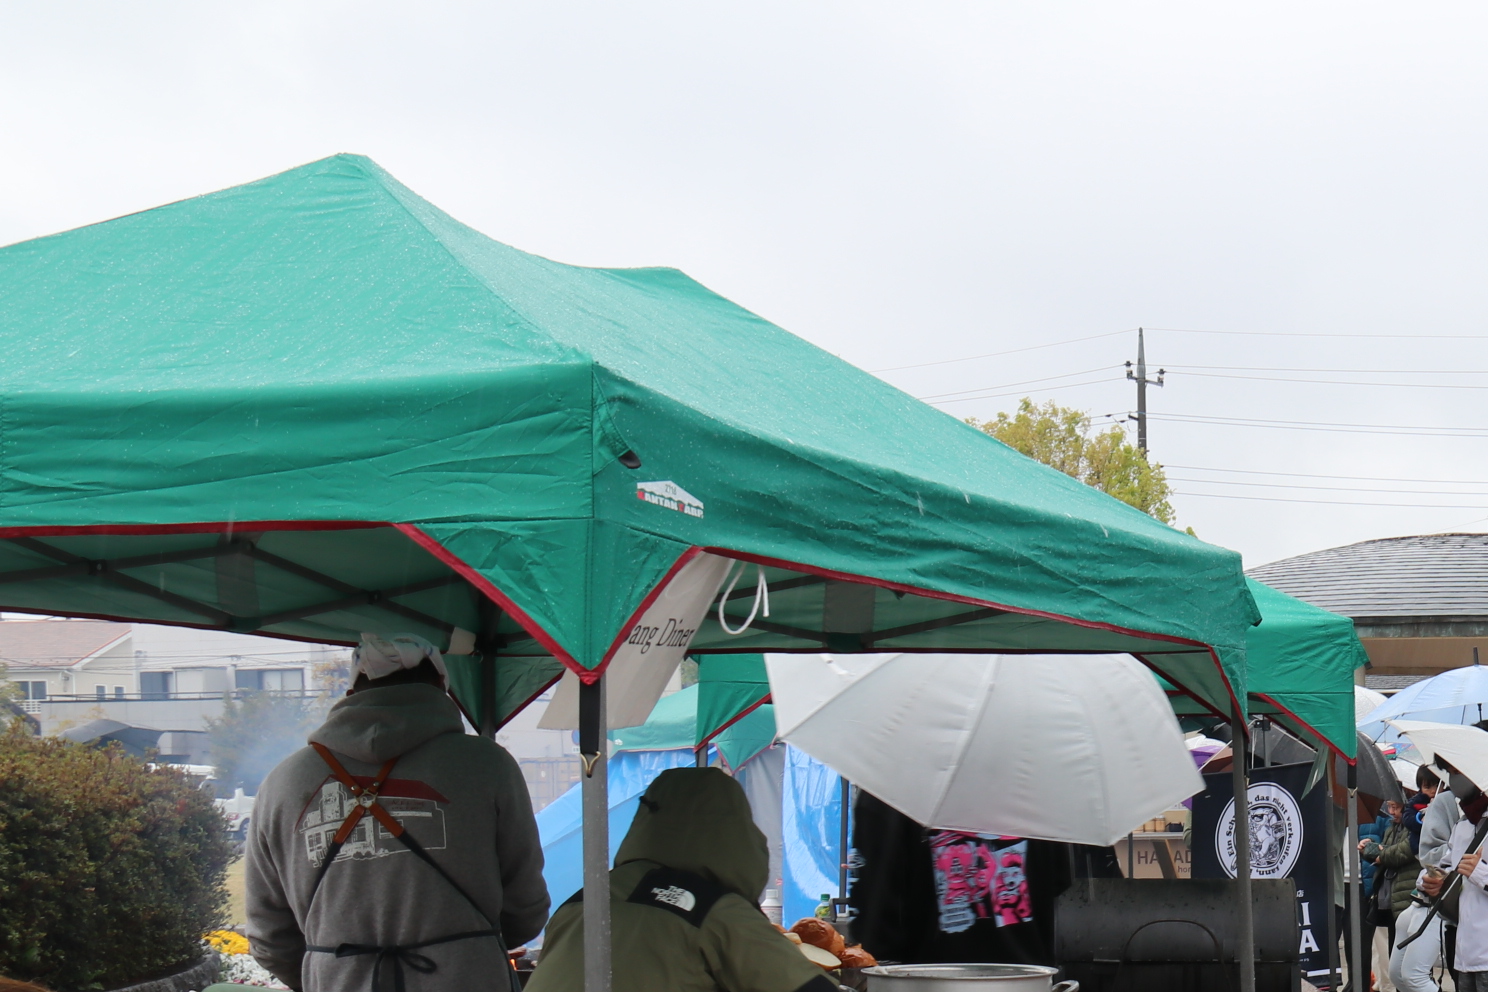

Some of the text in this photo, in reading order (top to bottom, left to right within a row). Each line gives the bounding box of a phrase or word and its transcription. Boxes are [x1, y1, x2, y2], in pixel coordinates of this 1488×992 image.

[625, 618, 696, 654] ang Diner
[1254, 794, 1270, 802] das
